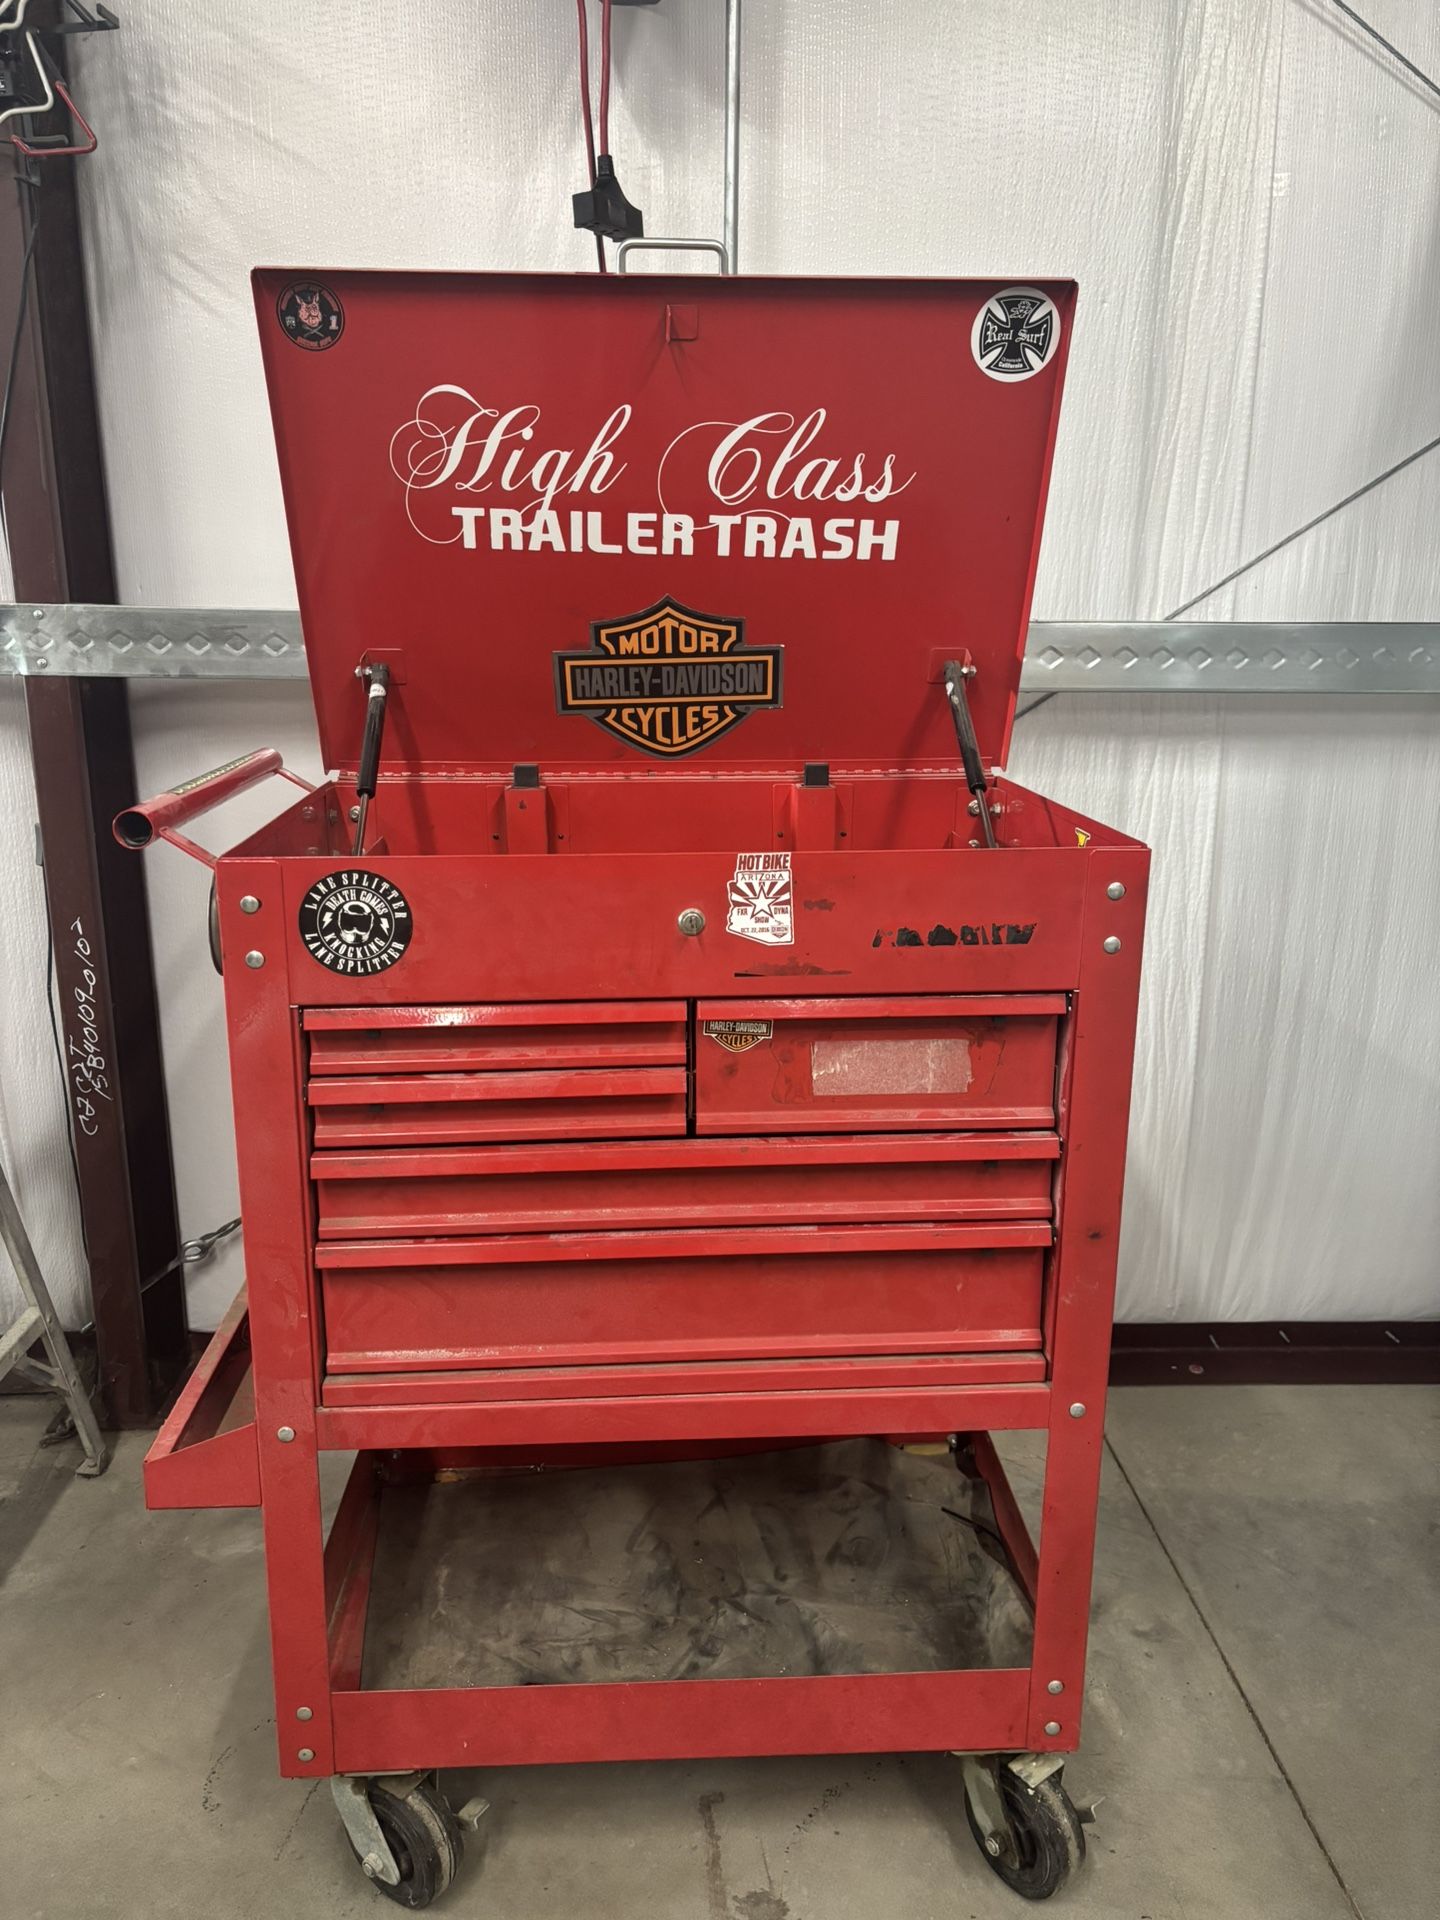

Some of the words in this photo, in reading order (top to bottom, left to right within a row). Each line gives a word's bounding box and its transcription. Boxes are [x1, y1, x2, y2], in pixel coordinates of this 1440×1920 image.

[985, 321, 1013, 345] Real
[1015, 324, 1047, 346] Surf
[390, 384, 631, 543] High
[658, 408, 916, 529] Class
[451, 507, 695, 556] TRAILER
[708, 514, 900, 561] TRASH
[618, 617, 720, 656] MOTOR
[574, 662, 764, 699] HARLEY-DAVIDSON
[621, 704, 720, 745] CYCLES
[737, 854, 762, 870] HOT
[762, 854, 790, 870] BIKE
[740, 872, 785, 881] ARIZONA
[304, 876, 337, 910] LANE
[341, 872, 407, 919] SPLITTER
[324, 889, 357, 911] DEATH
[359, 890, 389, 916] COMES
[754, 916, 769, 924] SHOW
[773, 906, 789, 915] DYNA
[304, 932, 335, 965] LANE
[337, 941, 405, 974] SPLITTER
[323, 932, 386, 959] KNOCKING
[709, 1020, 768, 1034] HARLEY-DAVIDSON
[721, 1033, 753, 1047] CYCLES
